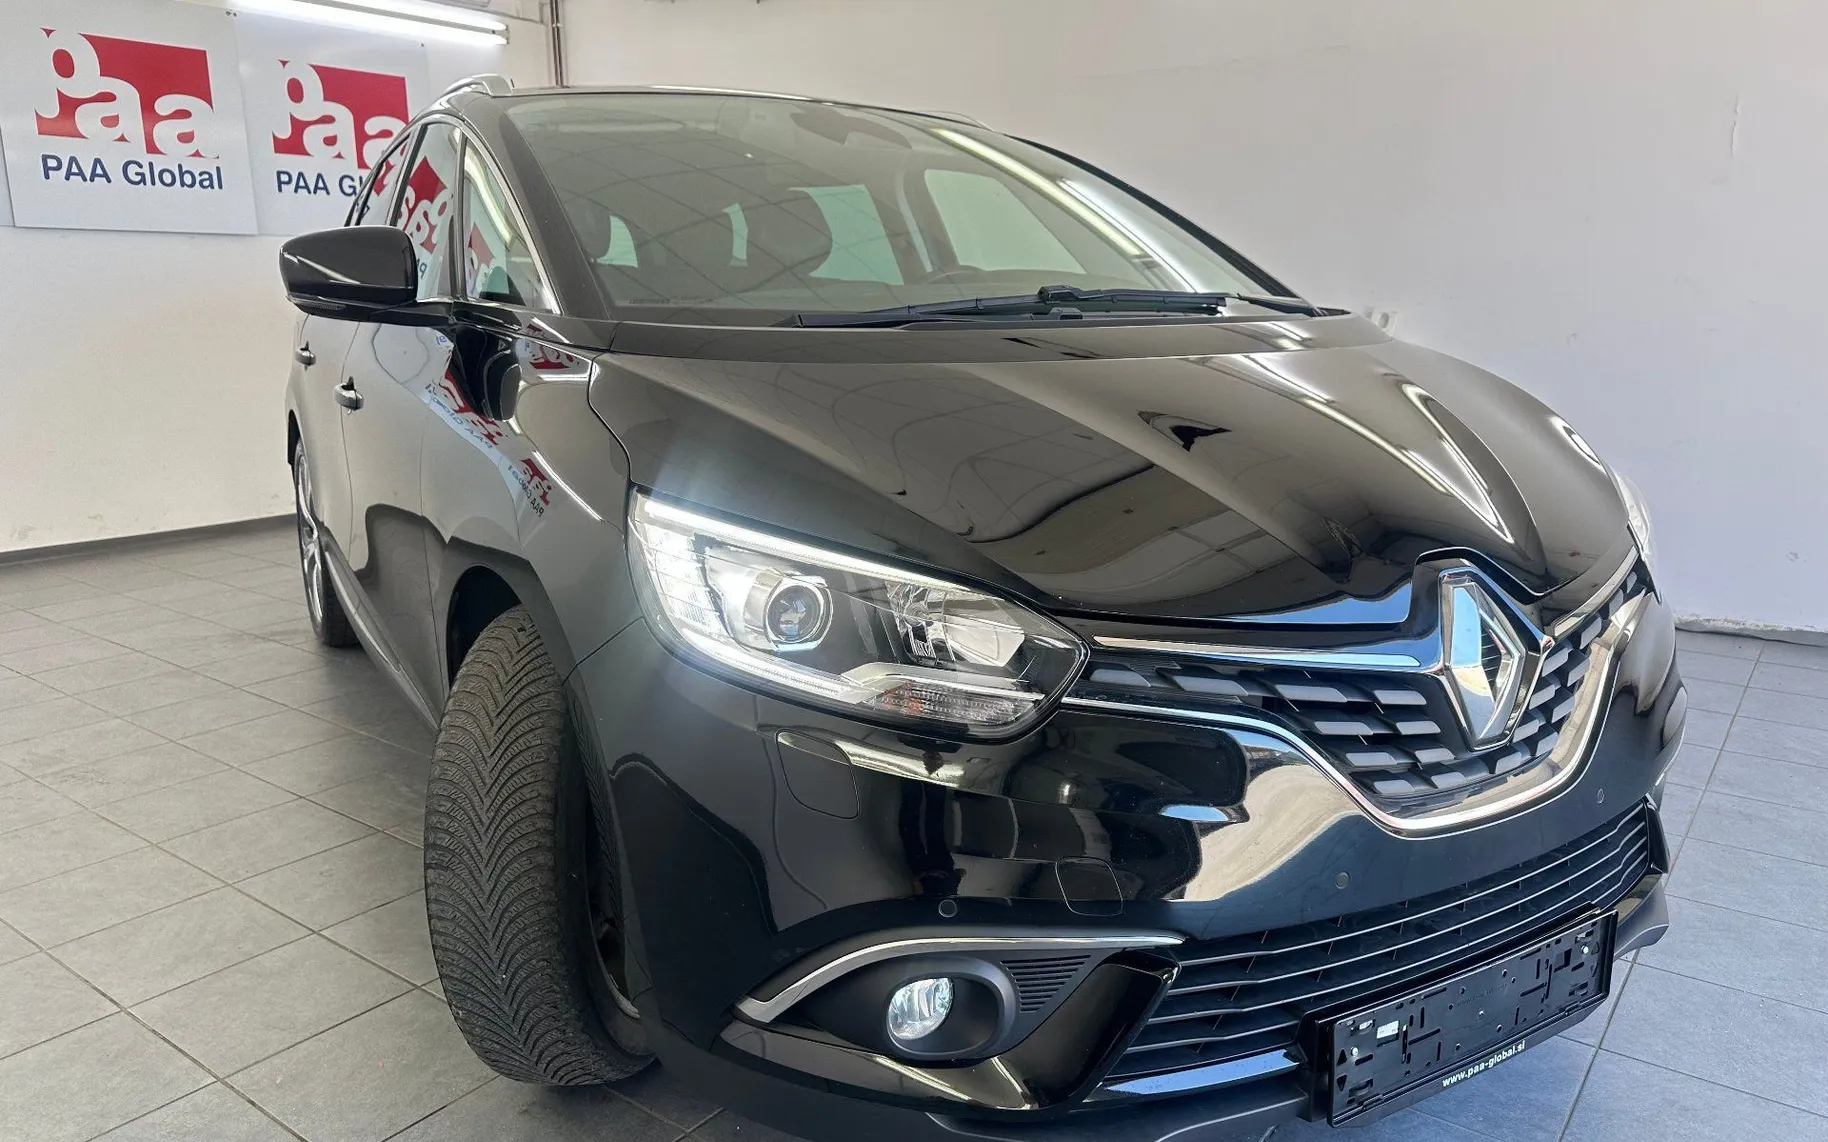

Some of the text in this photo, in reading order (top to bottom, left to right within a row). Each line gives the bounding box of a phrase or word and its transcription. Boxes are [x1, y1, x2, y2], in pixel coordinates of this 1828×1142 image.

[42, 154, 223, 190] PAA Global
[276, 170, 330, 196] PAA
[1442, 1039, 1526, 1087] www.paa-global.si
